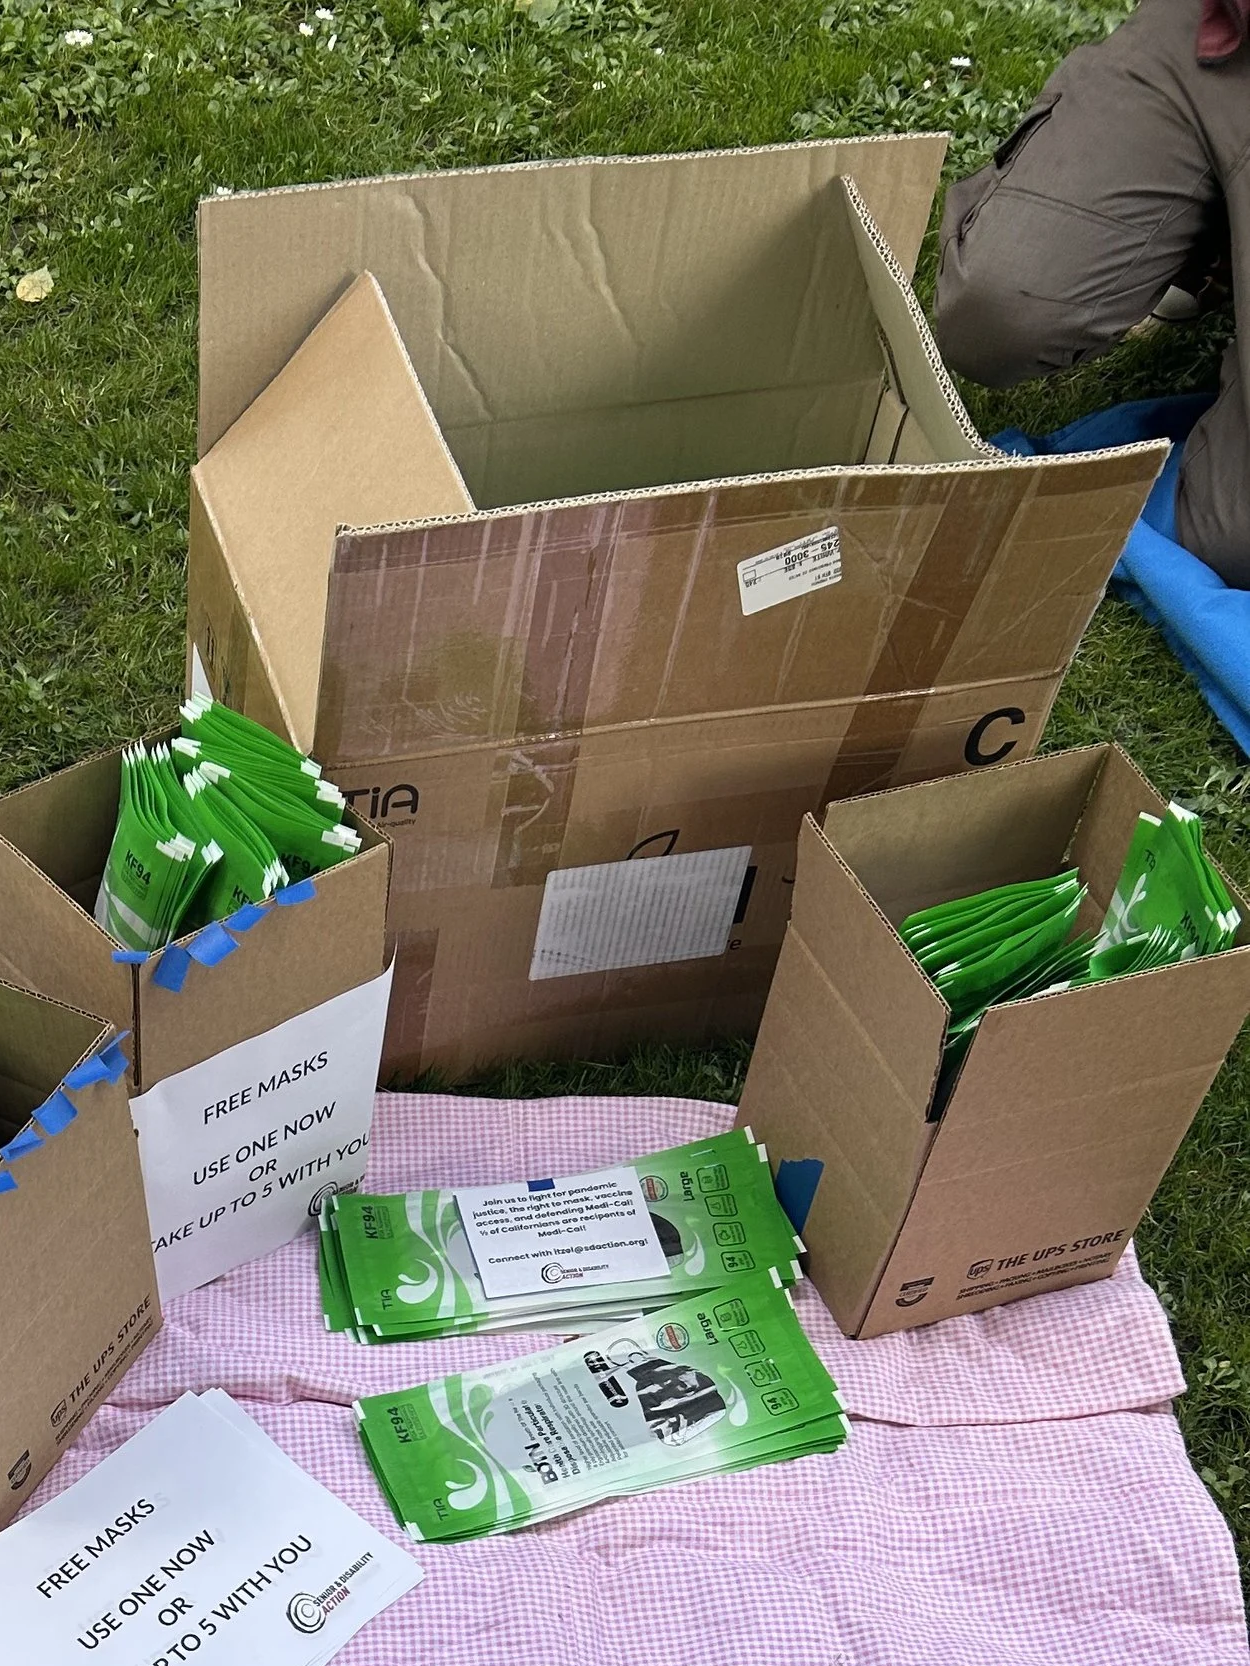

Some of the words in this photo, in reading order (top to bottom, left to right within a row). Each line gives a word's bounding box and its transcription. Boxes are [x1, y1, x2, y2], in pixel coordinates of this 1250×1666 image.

[964, 707, 1026, 767] C
[125, 850, 151, 885] KF94
[204, 1087, 252, 1124] FREE
[258, 1051, 328, 1098] MASKS
[193, 1154, 230, 1185] USE
[236, 1130, 278, 1163] ONE
[283, 1101, 336, 1140] NOW
[249, 1158, 278, 1182] OR
[680, 1171, 695, 1201] Large
[152, 1222, 194, 1253] AKE
[199, 1206, 226, 1229] UP
[230, 1192, 257, 1213] TO
[262, 1182, 272, 1199] 5
[278, 1153, 331, 1189] WITH
[483, 1195, 503, 1207] Join
[504, 1196, 516, 1204] us
[517, 1195, 527, 1203] to
[529, 1192, 552, 1202] fight
[553, 1189, 566, 1198] for
[568, 1182, 617, 1197] pandemic
[534, 1206, 584, 1220] defending
[595, 1190, 633, 1200] vaccine
[364, 1205, 379, 1239] KF94
[488, 1252, 530, 1264] Connect
[531, 1249, 553, 1258] with
[997, 1253, 1029, 1271] THE
[1032, 1244, 1068, 1262] UPS
[1071, 1228, 1129, 1251] STORE
[697, 1312, 721, 1345] Large
[70, 1372, 91, 1402] THE
[93, 1342, 114, 1374] UPS
[117, 1293, 150, 1343] STORE
[397, 1405, 413, 1445] KF94
[36, 1552, 91, 1599] FREE
[84, 1497, 156, 1559] MASKS
[77, 1612, 124, 1651] USE
[118, 1573, 167, 1616] ONE
[159, 1529, 216, 1580] NOW
[312, 1581, 338, 1607] SENIOR
[339, 1551, 375, 1584] DISABILITY
[157, 1596, 194, 1627] OR
[166, 1632, 202, 1663] TO
[199, 1617, 218, 1636] 5
[210, 1572, 272, 1621] WITH
[264, 1533, 312, 1575] YOU
[321, 1586, 351, 1616] ACTION
